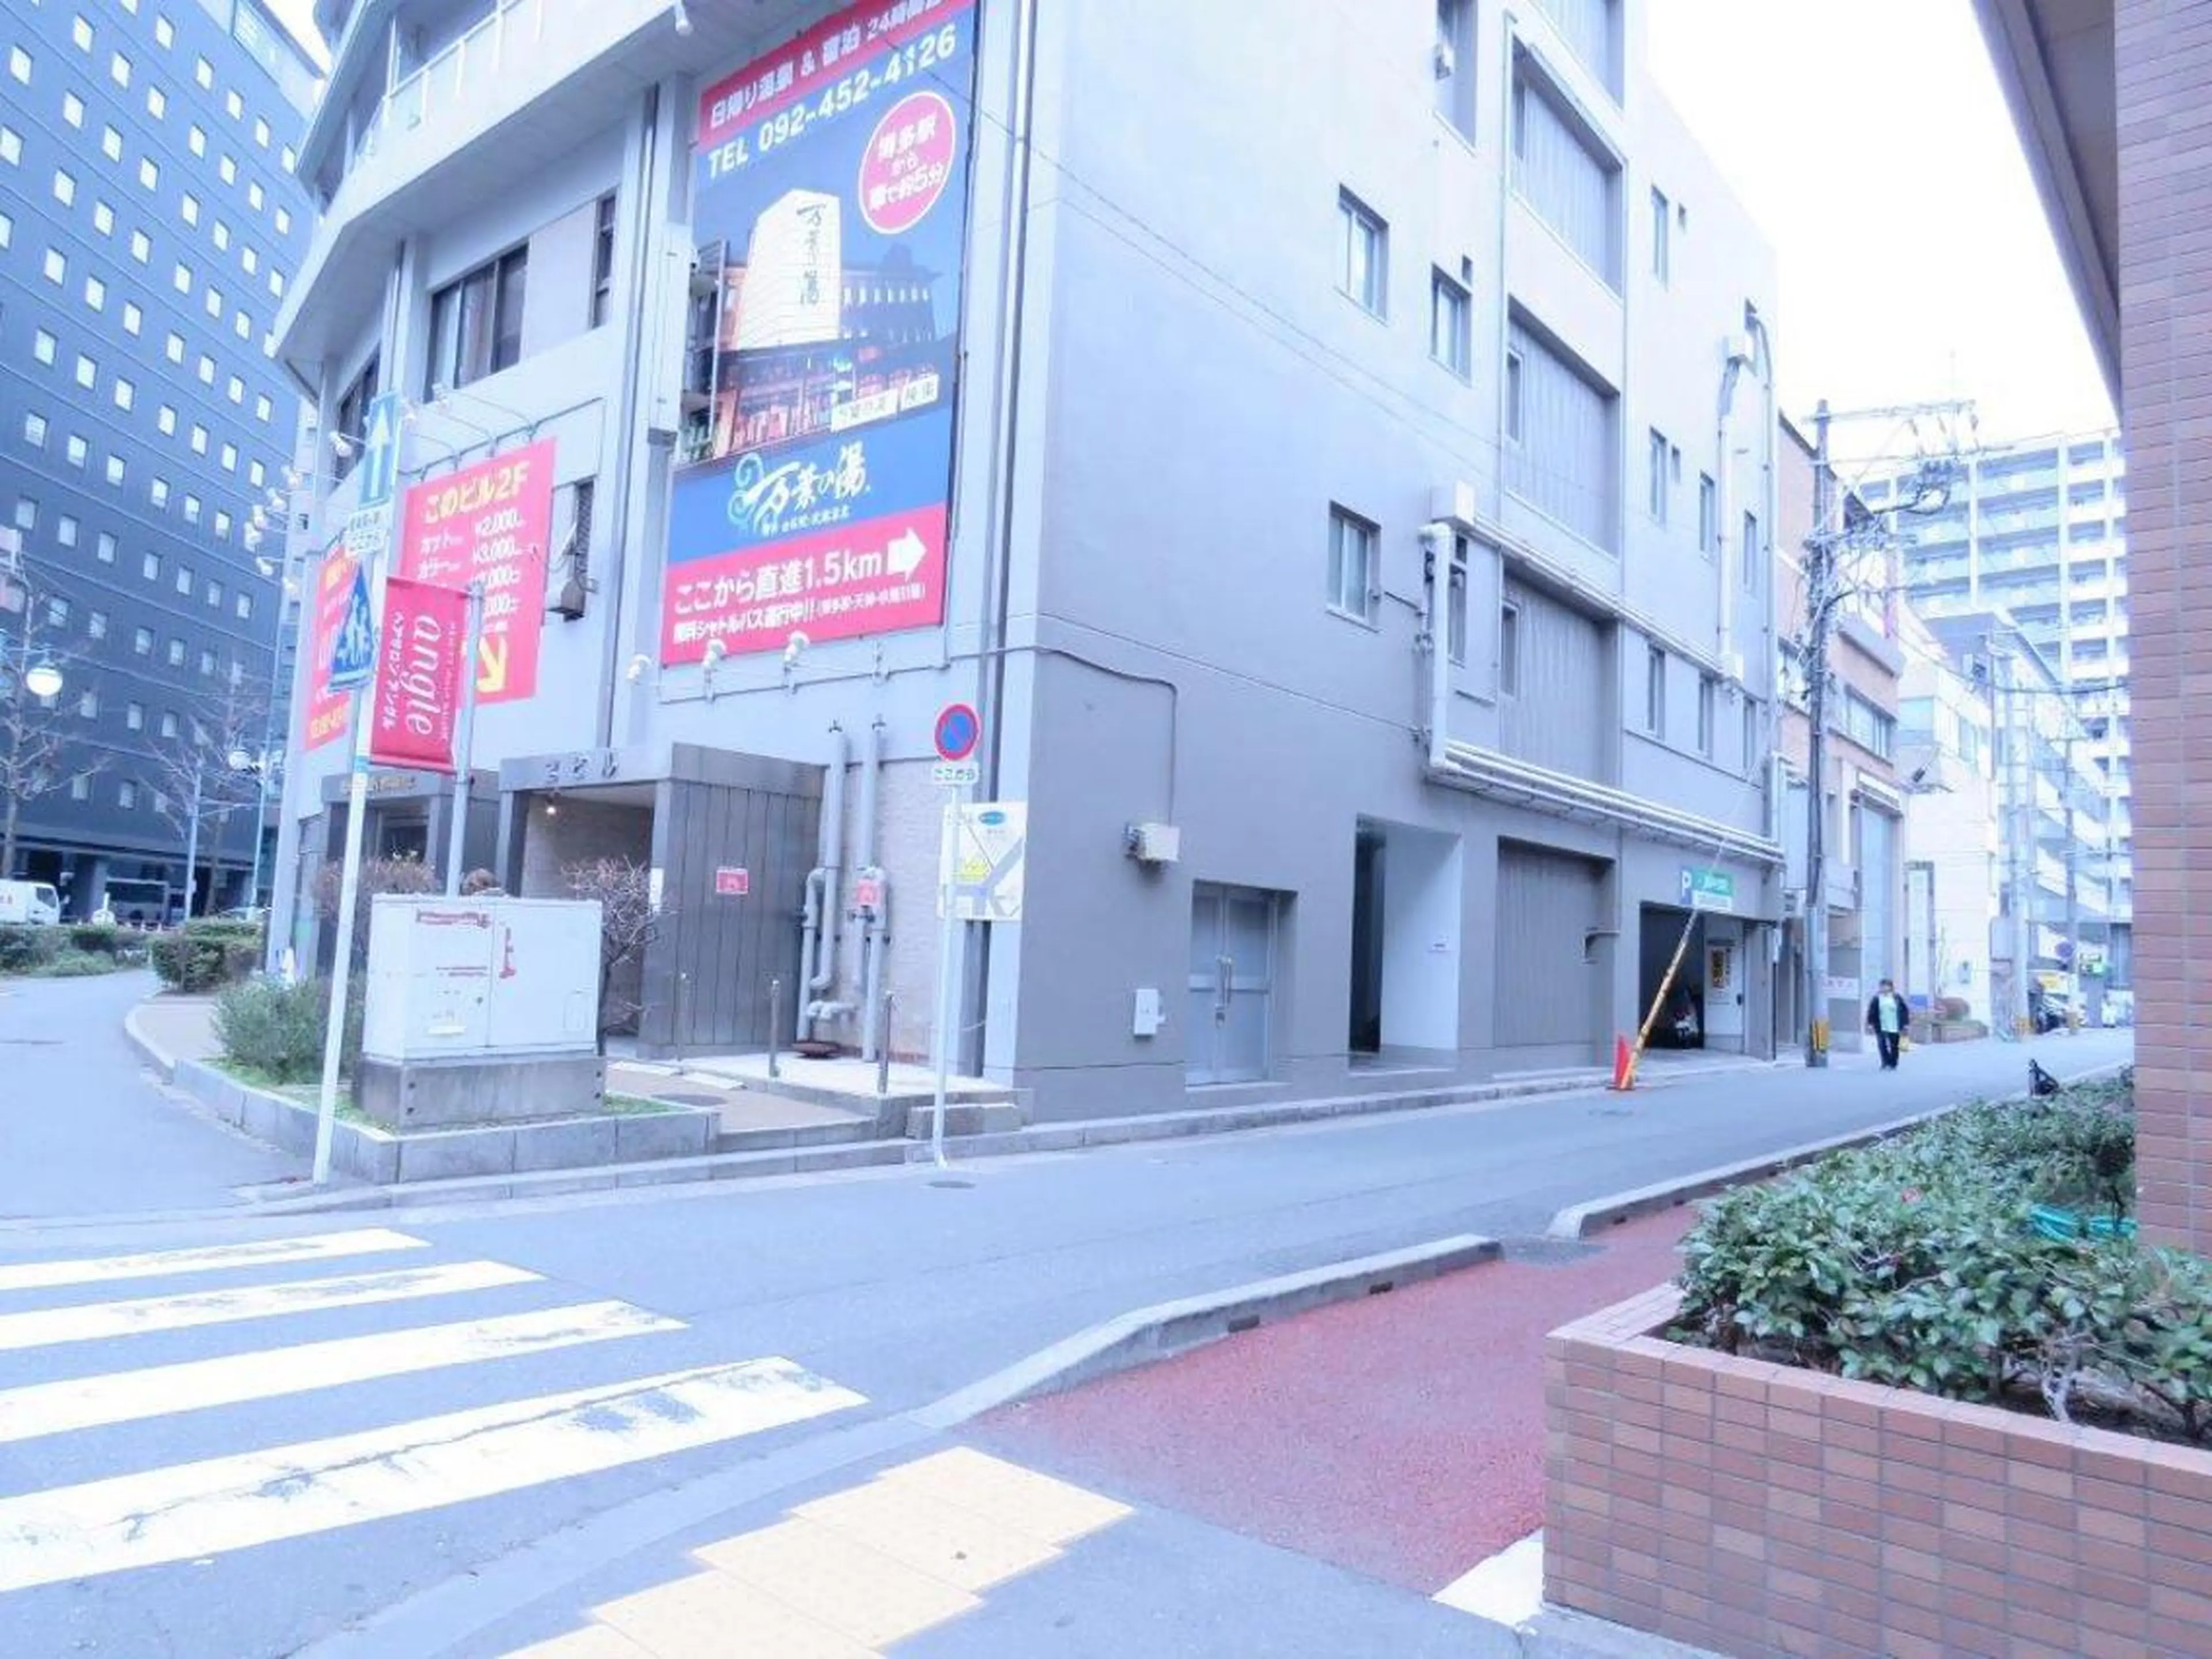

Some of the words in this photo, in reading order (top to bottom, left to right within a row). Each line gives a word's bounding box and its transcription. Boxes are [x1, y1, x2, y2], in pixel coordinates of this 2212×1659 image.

[707, 137, 749, 180] TEL
[758, 22, 957, 152] 092-452-4126
[425, 461, 530, 524] このビル2F
[675, 549, 882, 614] ここから直進1.5km
[399, 613, 442, 736] angle
[1681, 870, 1692, 897] P
